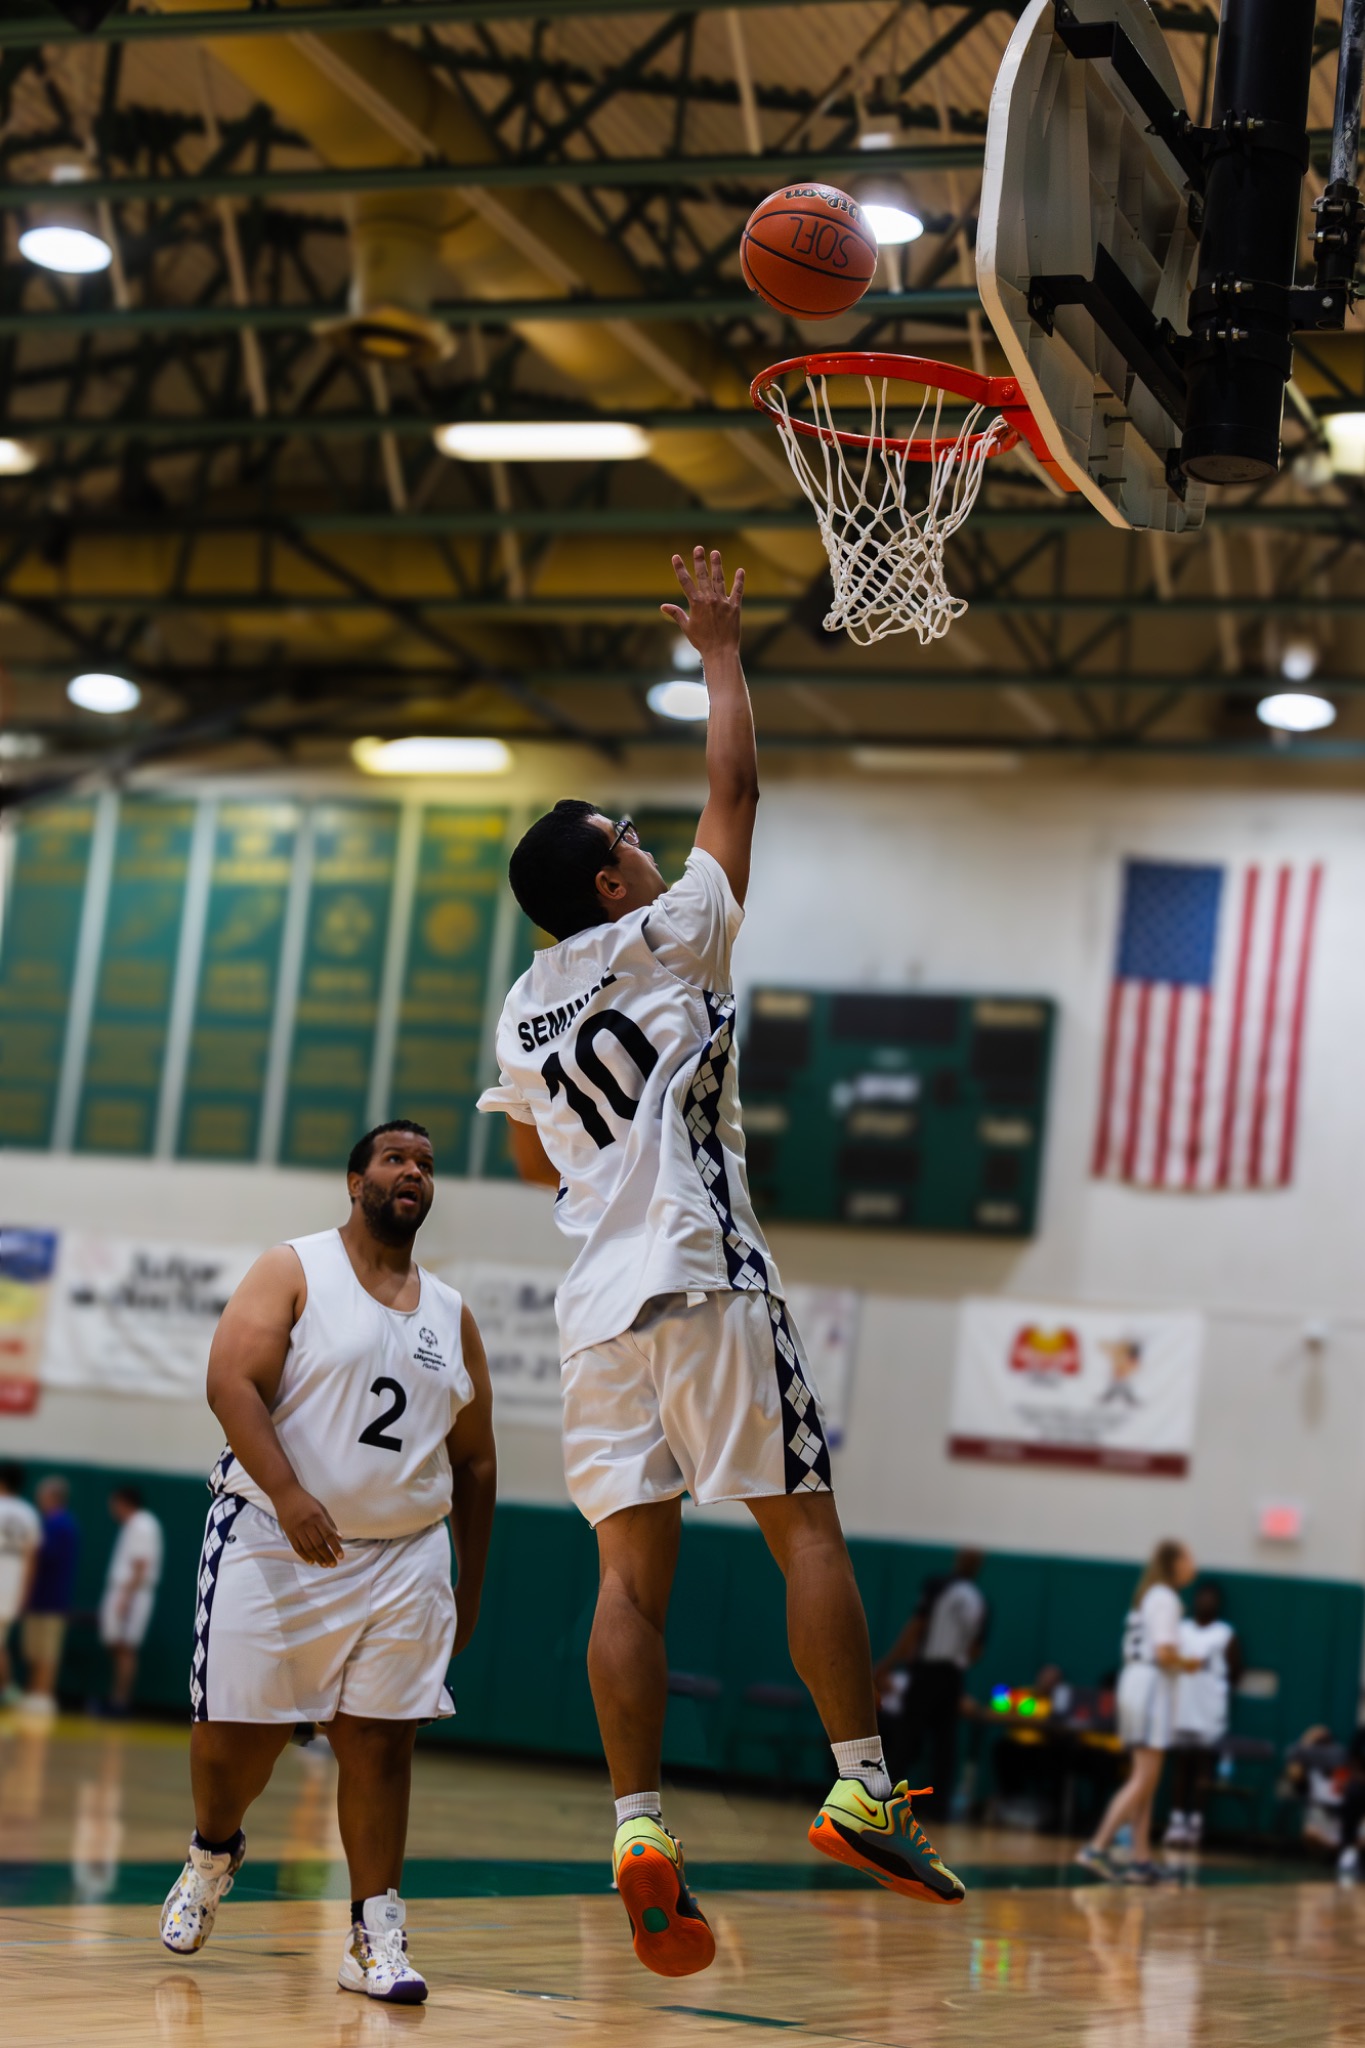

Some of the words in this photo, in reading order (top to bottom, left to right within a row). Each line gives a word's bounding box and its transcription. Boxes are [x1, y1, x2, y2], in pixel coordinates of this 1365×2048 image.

[790, 216, 857, 269] SOFL
[517, 966, 618, 1053] SEMIN
[541, 1008, 659, 1150] 10
[358, 1376, 407, 1452] 2
